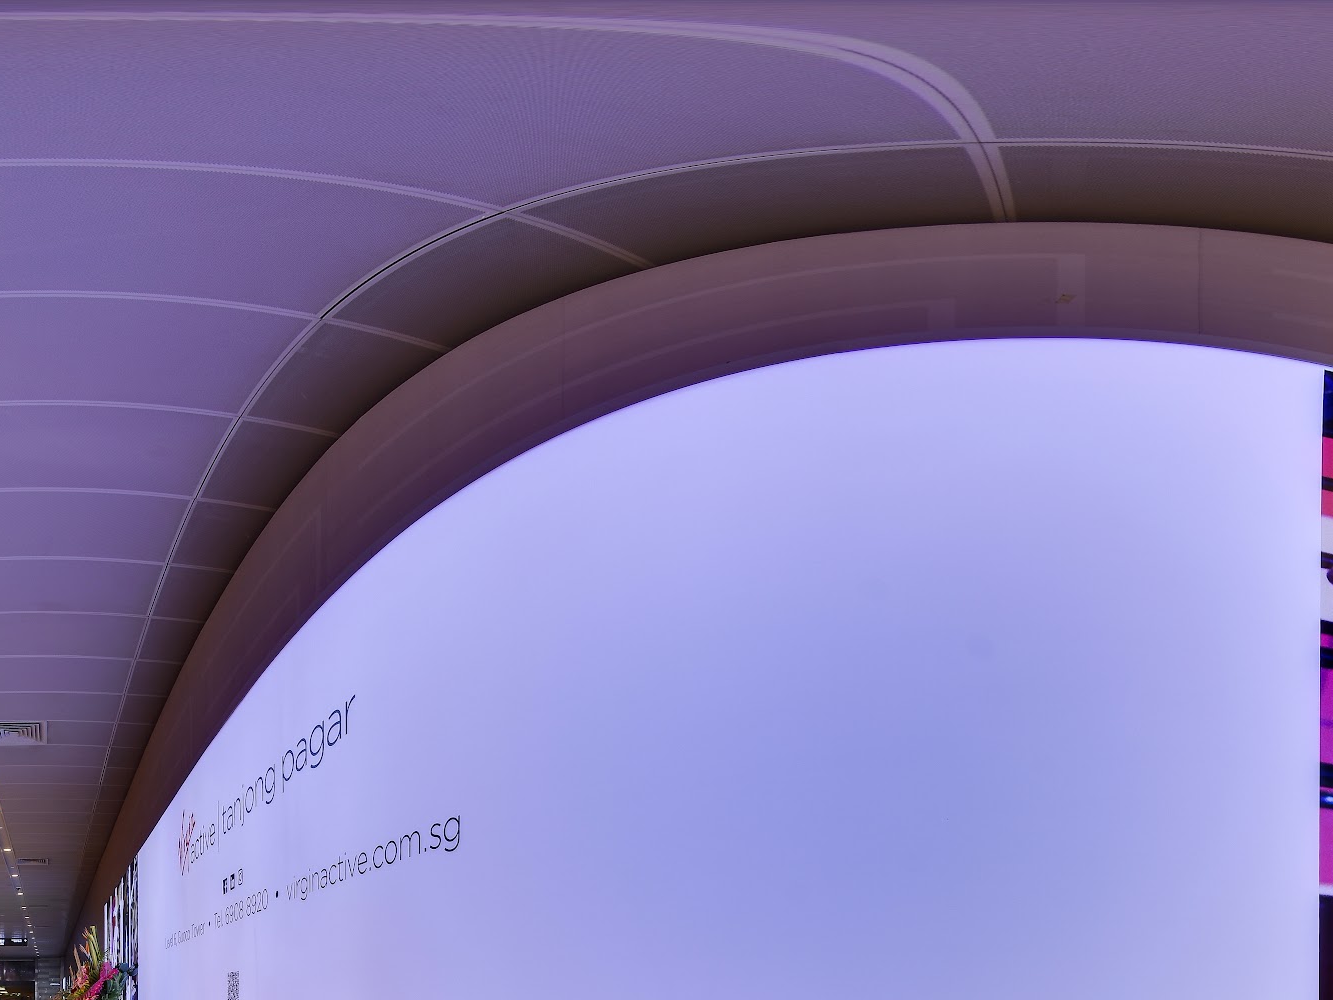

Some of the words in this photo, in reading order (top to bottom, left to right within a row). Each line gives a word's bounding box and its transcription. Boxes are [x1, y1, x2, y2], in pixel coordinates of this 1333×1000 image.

[190, 823, 216, 864] active
[221, 764, 276, 834] tanjong
[282, 694, 356, 793] pagar
[191, 922, 205, 938] Tower
[225, 900, 244, 925] 6908
[246, 888, 269, 917] 8920
[286, 815, 461, 901] virginactive.com.sg
